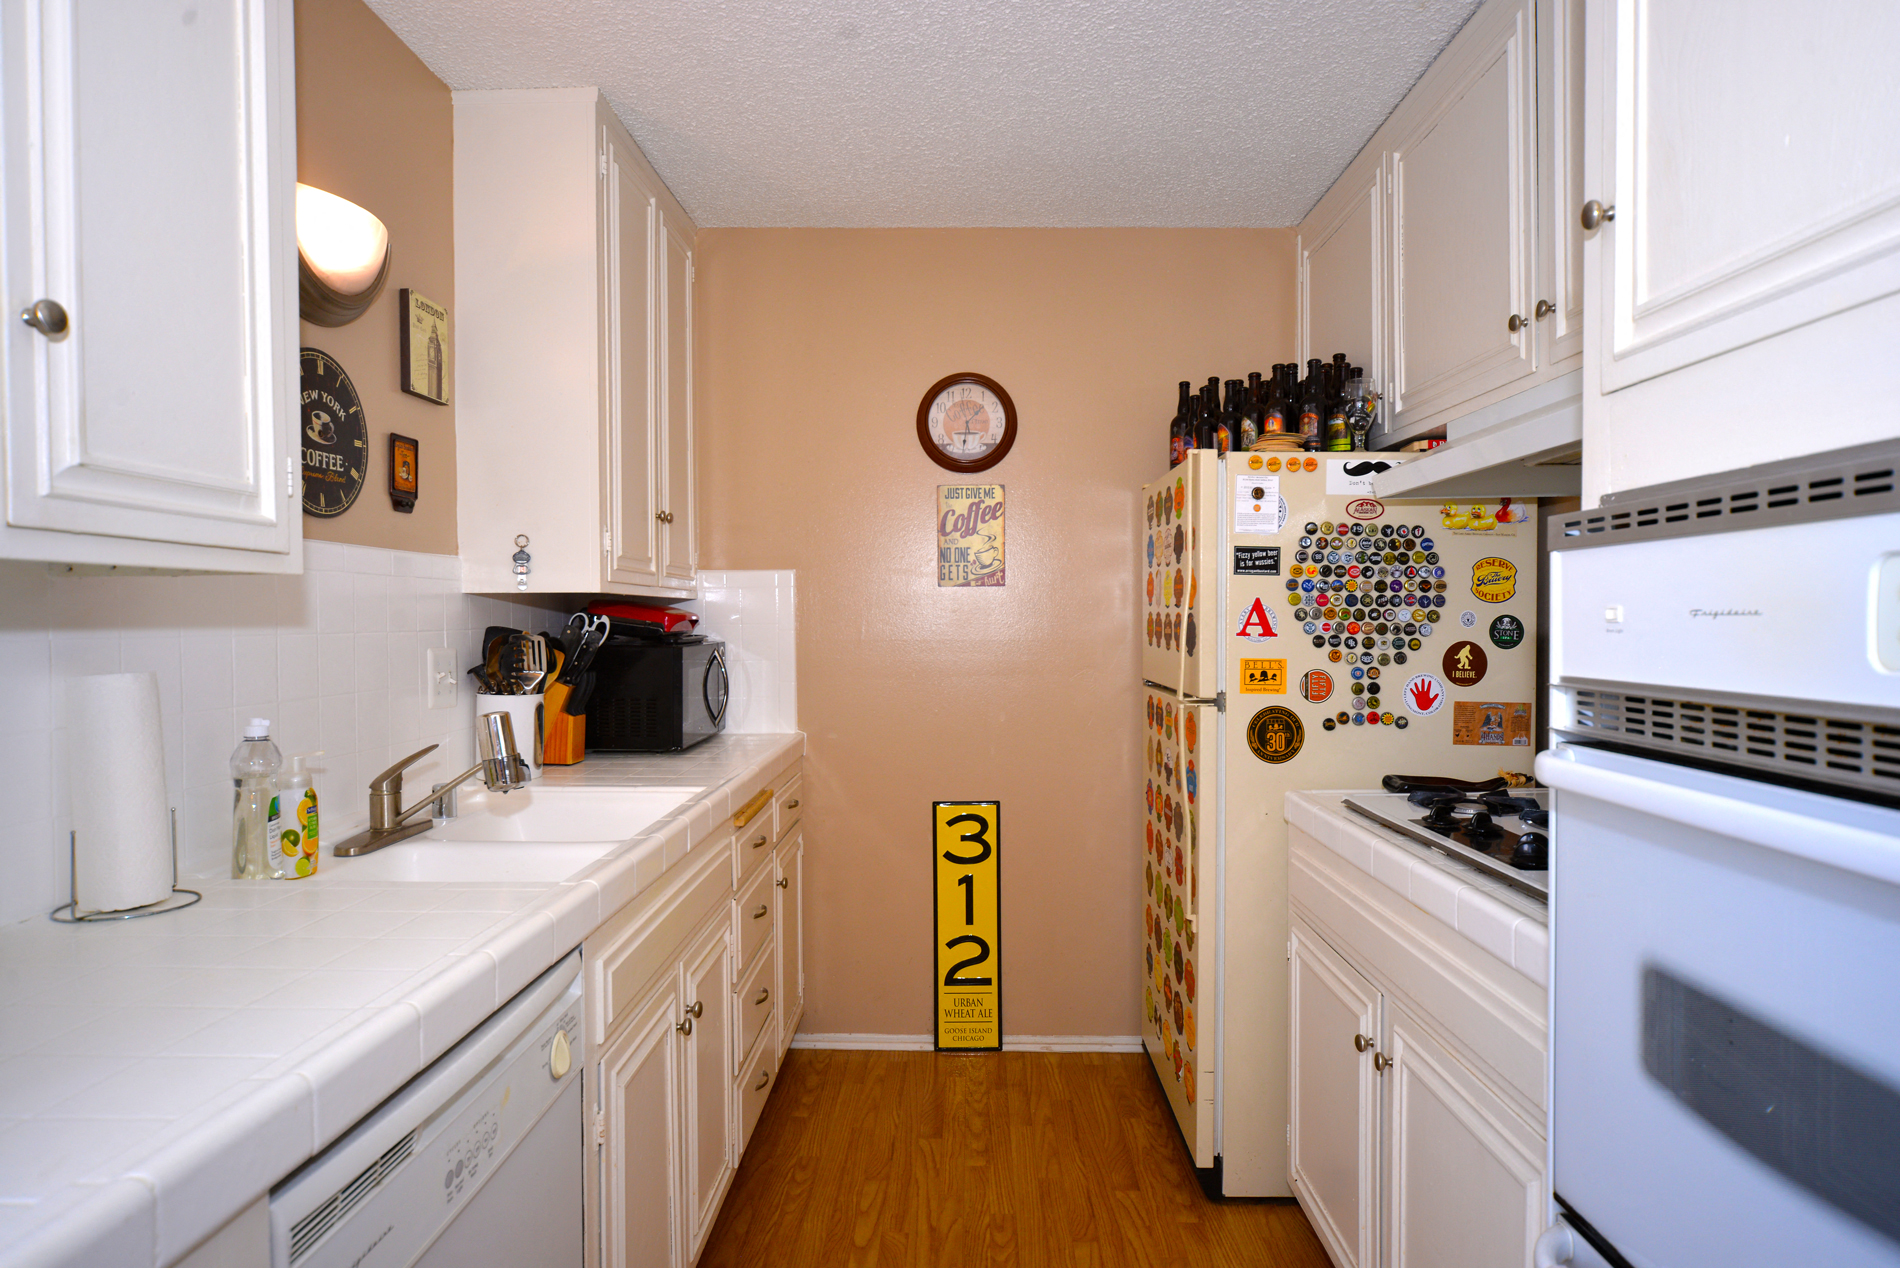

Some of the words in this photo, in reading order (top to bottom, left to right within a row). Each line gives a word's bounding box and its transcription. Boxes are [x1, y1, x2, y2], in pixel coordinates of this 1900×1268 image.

[415, 298, 445, 321] LONDON
[320, 391, 346, 421] YORK
[936, 402, 946, 413] 10
[992, 401, 999, 413] 2
[301, 446, 344, 471] COFFEE
[945, 488, 964, 499] JUST
[965, 488, 982, 499] GIVE
[984, 488, 995, 499] ME
[940, 499, 1004, 539] Coffee
[940, 547, 951, 563] NO
[954, 547, 971, 563] ONE
[1252, 550, 1267, 559] yellow
[1476, 559, 1513, 572] RESERVE
[940, 565, 968, 580] GETS
[984, 570, 1005, 586] hurt
[1475, 587, 1511, 601] SOCIETY
[1236, 597, 1278, 637] A
[1689, 608, 1763, 620] Frigidaire
[1494, 629, 1519, 640] STONE
[1244, 661, 1284, 669] BELL'S
[1311, 674, 1319, 695] FIFTY
[953, 998, 984, 1007] URBAN
[944, 1009, 976, 1018] WHEAT
[977, 1009, 993, 1018] ALE
